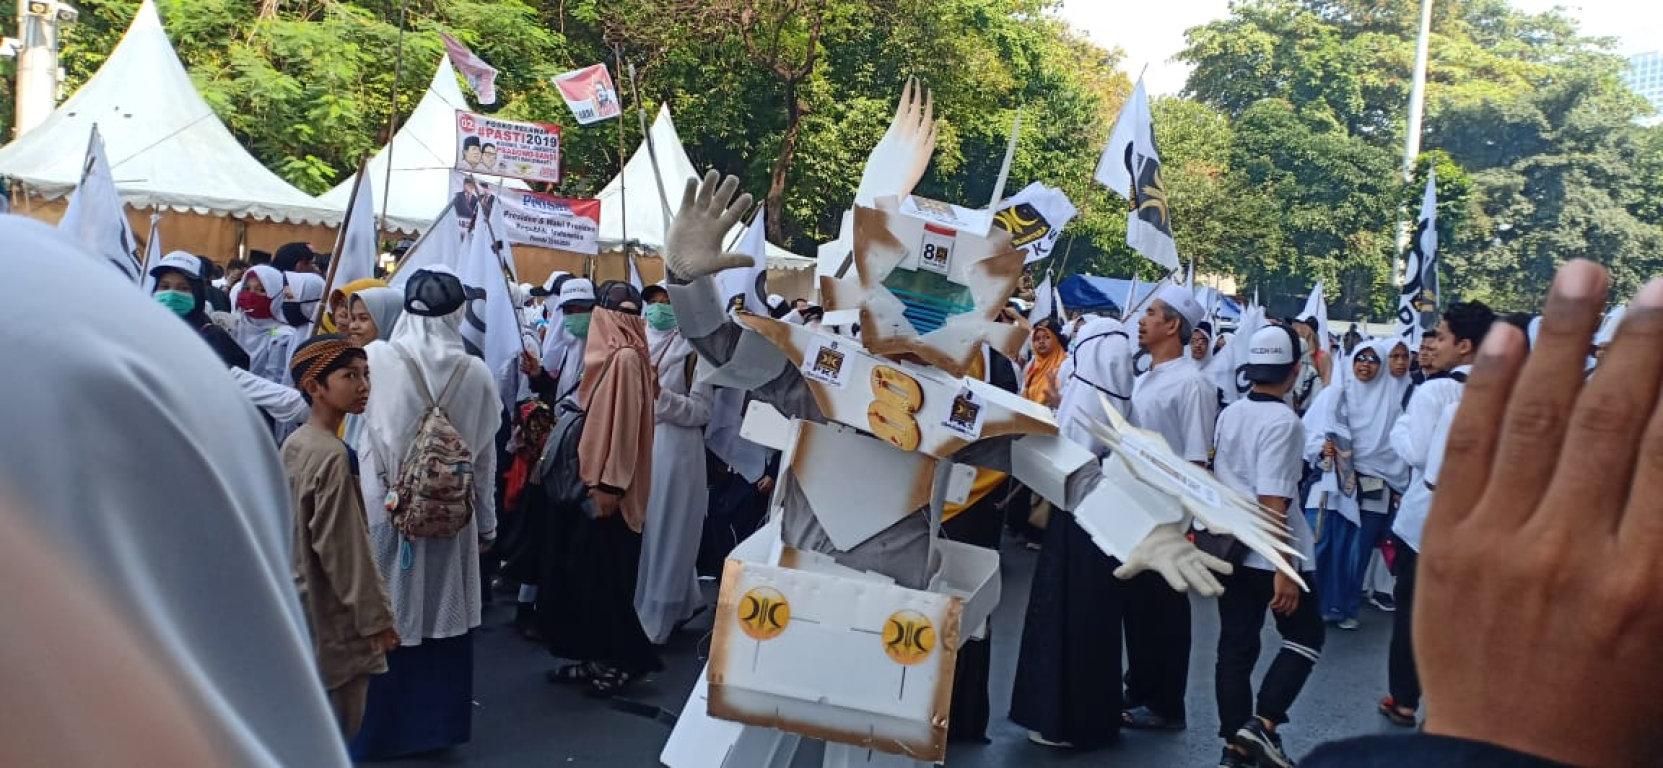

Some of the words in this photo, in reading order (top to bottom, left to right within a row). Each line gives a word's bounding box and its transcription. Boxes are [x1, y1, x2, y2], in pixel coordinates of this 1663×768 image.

[461, 118, 473, 128] 02
[478, 126, 557, 147] #PASTI2019
[923, 243, 935, 260] 8
[868, 364, 924, 452] 8
